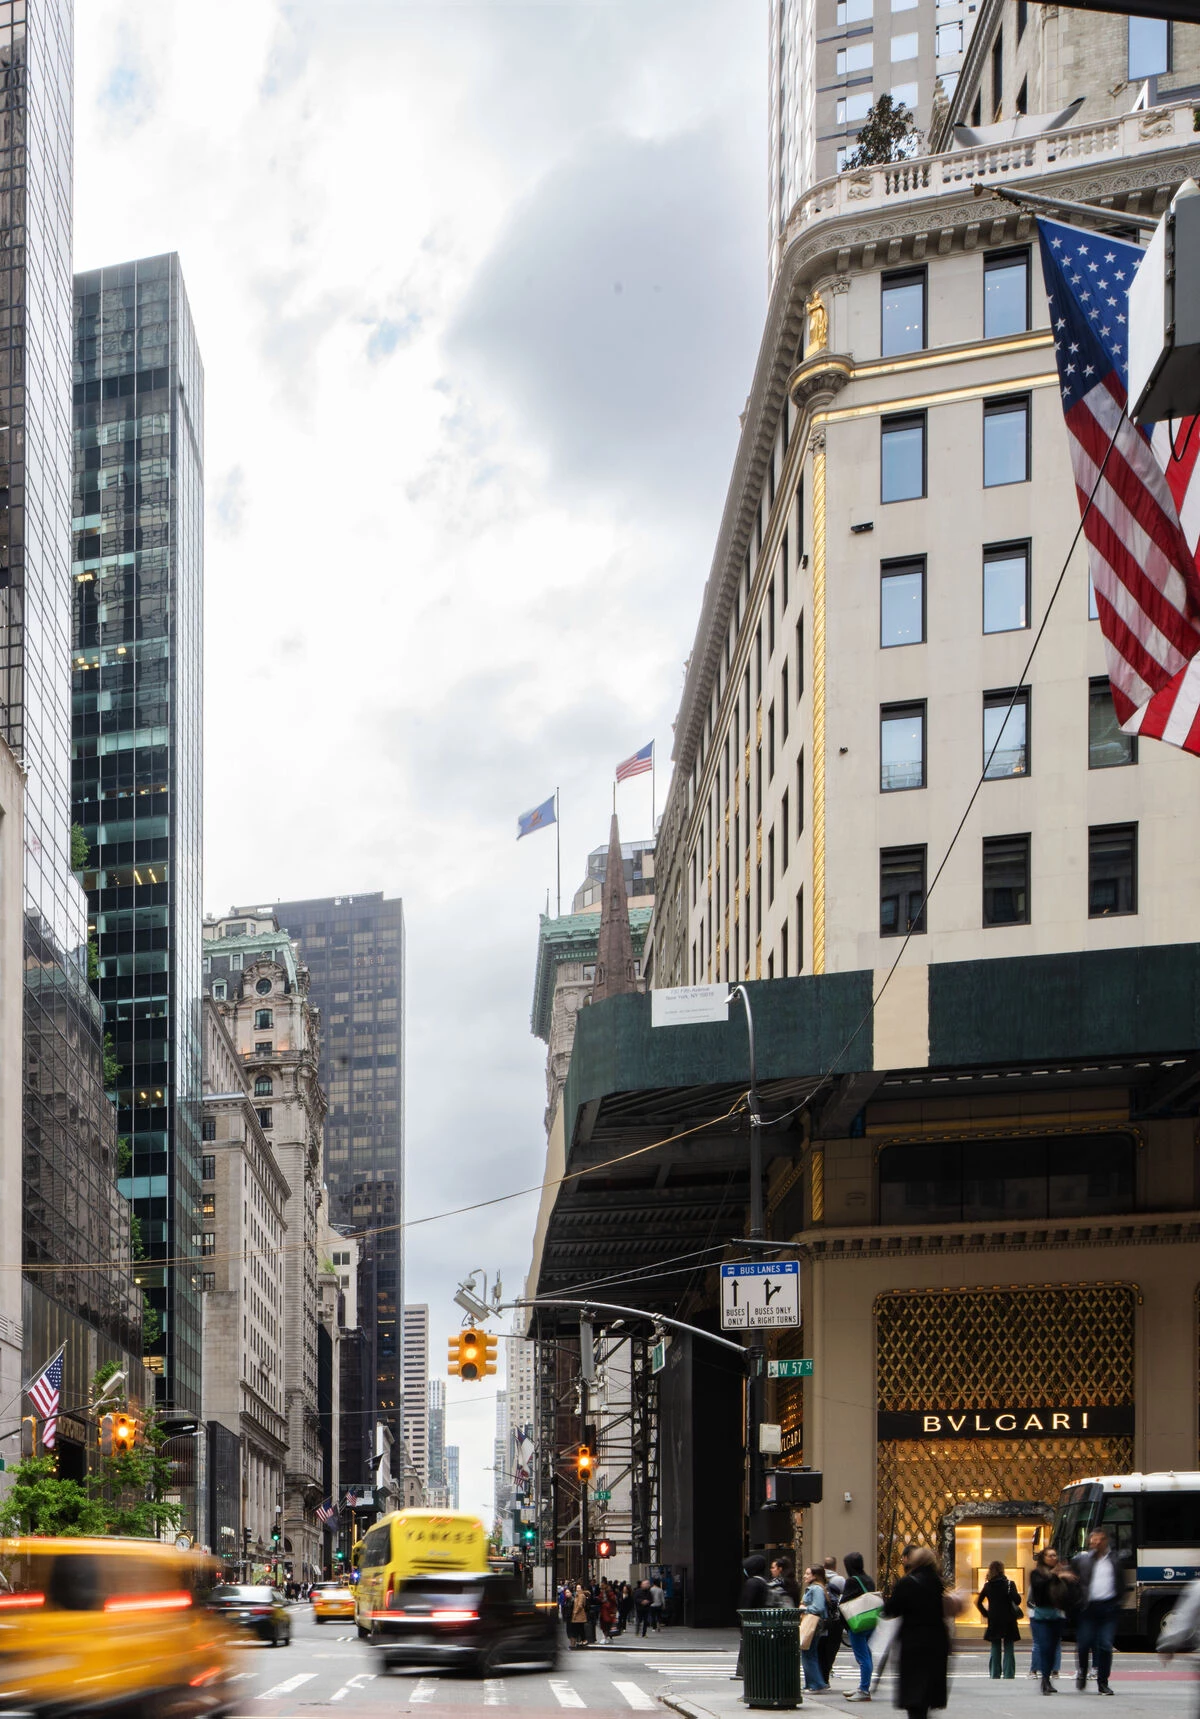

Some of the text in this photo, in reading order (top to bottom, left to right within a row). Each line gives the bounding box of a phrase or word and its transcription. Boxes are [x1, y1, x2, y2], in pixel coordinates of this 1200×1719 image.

[740, 1265, 781, 1275] BUS LANES
[726, 1308, 745, 1326] BUSES ONLY
[754, 1306, 792, 1316] BUSES ONLY
[750, 1315, 797, 1325] & RIGHT TURNS
[780, 1362, 788, 1375] W
[792, 1361, 803, 1375] 57
[923, 1412, 1088, 1432] BVLGARI
